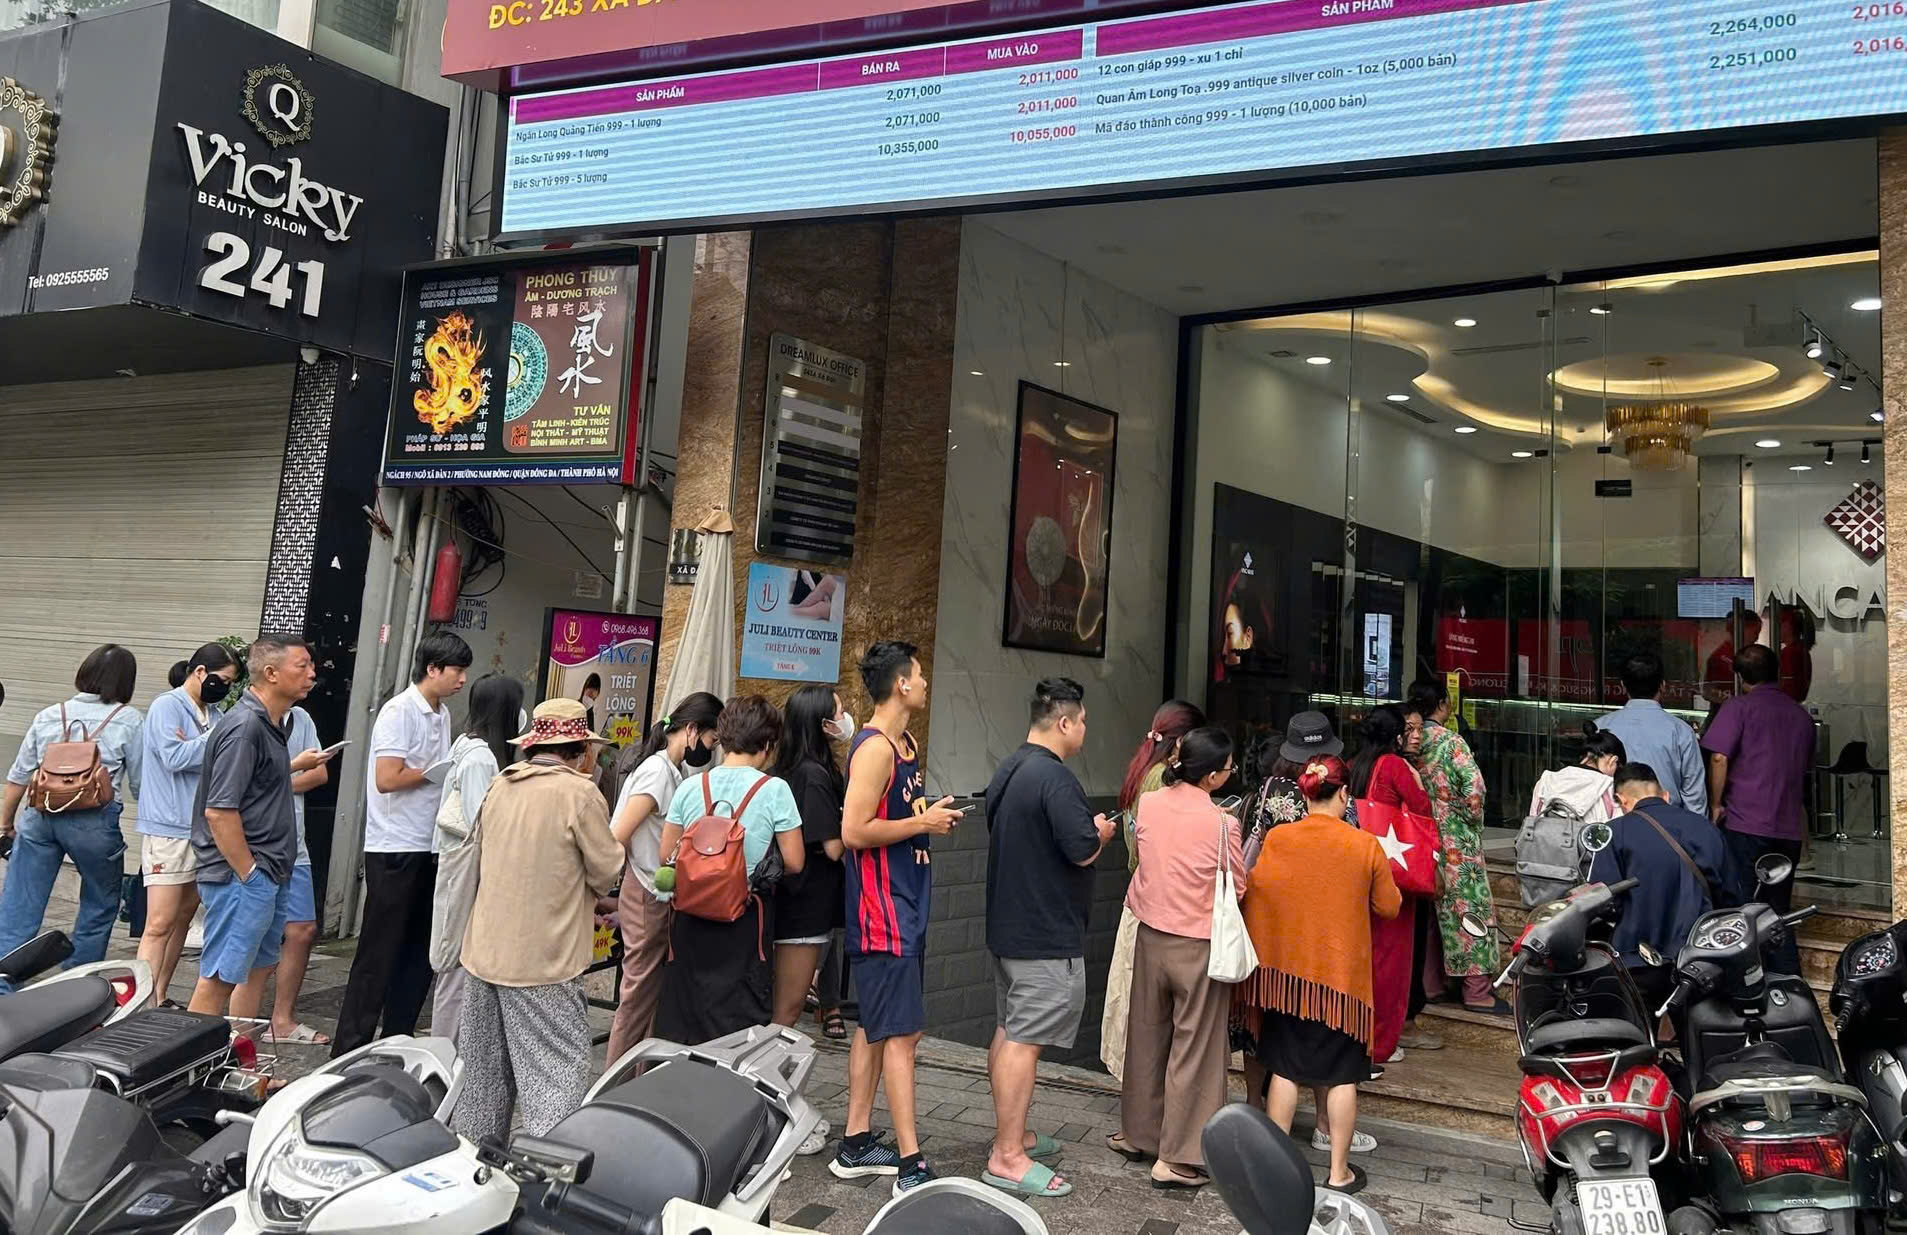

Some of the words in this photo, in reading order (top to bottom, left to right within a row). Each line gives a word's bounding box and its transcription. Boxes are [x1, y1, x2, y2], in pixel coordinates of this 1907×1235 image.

[489, 1, 533, 29] ĐC:
[539, 0, 583, 21] 243
[1709, 14, 1797, 37] 2,264,000
[987, 46, 1013, 60] MUA
[1015, 43, 1039, 57] VÀO
[1709, 48, 1797, 70] 2,251,000
[861, 62, 884, 76] BÁN
[885, 61, 900, 73] RA
[1097, 63, 1112, 76] 12
[1113, 64, 1135, 75] con
[1137, 57, 1162, 74] giáp
[1165, 55, 1187, 68] 999
[1197, 53, 1212, 64] xu
[1215, 51, 1220, 62] 1
[1224, 47, 1243, 61] chỉ
[1018, 68, 1078, 86] 2,011,000
[1096, 91, 1126, 106] Quan
[1127, 87, 1148, 101] Âm
[1149, 85, 1178, 101] Long
[1204, 79, 1230, 93] .999
[1233, 74, 1278, 90] antique
[1280, 69, 1315, 84] silver
[1317, 67, 1343, 79] coin
[1357, 62, 1379, 75] 1oz
[1382, 56, 1425, 75] (5,000
[1427, 53, 1457, 68] bản)
[635, 88, 655, 103] SẢN
[656, 85, 685, 101] PHẨM
[886, 84, 942, 101] 2,071,000
[269, 83, 300, 131] Q
[1017, 97, 1077, 114] 2,011,000
[1115, 117, 1137, 132] đáo
[1139, 112, 1173, 129] thành
[1174, 111, 1203, 126] công
[1206, 109, 1228, 122] 999
[1240, 107, 1246, 118] 1
[1250, 103, 1285, 118] lượng
[1288, 97, 1337, 115] (10,000
[1338, 94, 1367, 108] bản)
[538, 128, 558, 140] Long
[606, 120, 623, 131] 999
[631, 119, 635, 128] 1
[637, 117, 662, 129] lượng
[885, 112, 940, 128] 2,071,000
[1009, 125, 1076, 143] 10,055,000
[555, 150, 571, 161] 999
[579, 150, 583, 158] 1
[585, 147, 609, 159] lượng
[877, 139, 939, 157] 10,355,000
[178, 122, 363, 241] Vicky
[554, 174, 570, 185] 999
[577, 174, 582, 183] 5
[584, 172, 608, 184] lượng
[197, 190, 255, 220] BEAUTY
[263, 213, 307, 237] SALON
[29, 276, 45, 289] Tel:
[46, 268, 109, 288] 0925555565
[201, 231, 325, 317] 241
[526, 272, 575, 289] PHONG
[524, 291, 539, 302] ÂM
[546, 289, 582, 300] DƯƠNG
[584, 285, 617, 298] TRẠCH
[557, 308, 614, 399] 風水
[780, 343, 828, 369] DREAMLUX
[830, 359, 859, 378] OFFICE
[573, 406, 588, 416] TƯ
[590, 404, 611, 415] VẤN
[532, 420, 548, 428] TÂM
[548, 419, 566, 428] LINH
[589, 417, 610, 426] TRÚC
[530, 429, 544, 438] NỘI
[546, 427, 565, 437] THẤT
[584, 427, 610, 437] THUẬT
[530, 438, 548, 447] BÌNH
[549, 438, 568, 446] MINH
[569, 438, 585, 446] ART
[769, 441, 775, 449] 5
[478, 470, 493, 478] NAM
[560, 467, 582, 478] THÀNH
[766, 487, 771, 495] 3
[764, 510, 769, 518] 2
[677, 565, 688, 574] XÃ
[611, 623, 649, 636] 0968.496.368
[748, 623, 769, 635] JULI
[771, 625, 805, 639] BEAUTY
[806, 629, 838, 642] CENTER
[597, 635, 637, 664] TẦNG
[641, 650, 649, 665] 6
[611, 672, 637, 693] TRIỆT
[606, 693, 636, 711] LÔNG
[616, 726, 634, 737] 99K
